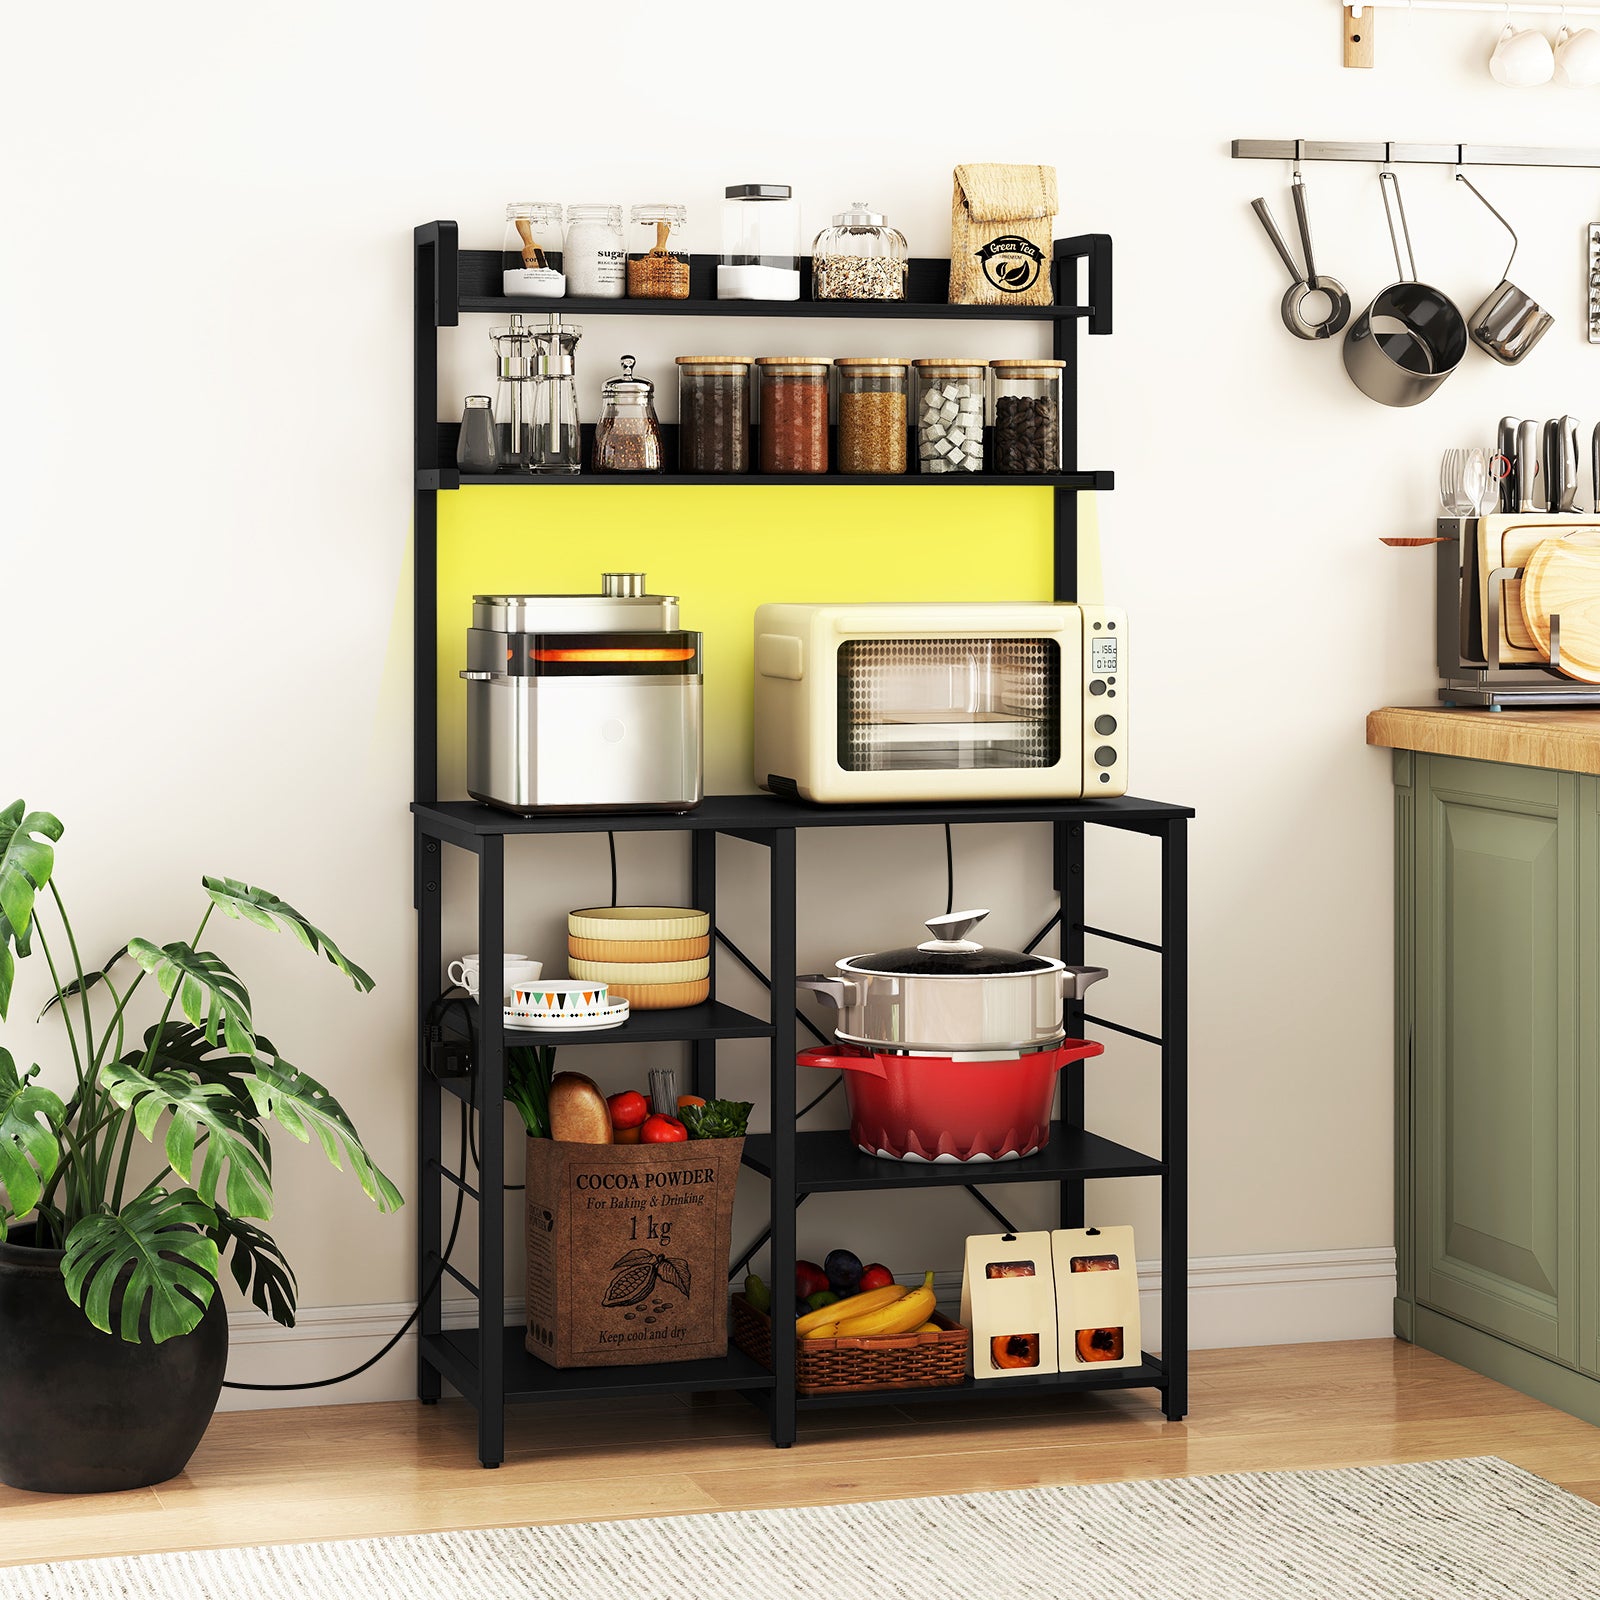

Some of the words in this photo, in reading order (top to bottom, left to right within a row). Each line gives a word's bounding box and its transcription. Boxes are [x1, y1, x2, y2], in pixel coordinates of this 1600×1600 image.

[597, 250, 625, 260] sugar
[990, 243, 1017, 253] Green
[1020, 242, 1036, 256] Tea
[576, 1173, 640, 1190] COCOA
[645, 1168, 715, 1189] POWDER
[586, 1197, 607, 1210] For
[610, 1196, 648, 1211] Baking
[649, 1195, 662, 1208] &
[661, 1192, 705, 1207] Drinking
[628, 1215, 639, 1241] 1
[646, 1214, 673, 1247] kg
[599, 1329, 625, 1346] Keep
[627, 1327, 648, 1342] cool
[649, 1326, 669, 1340] and
[670, 1325, 687, 1341] dry
